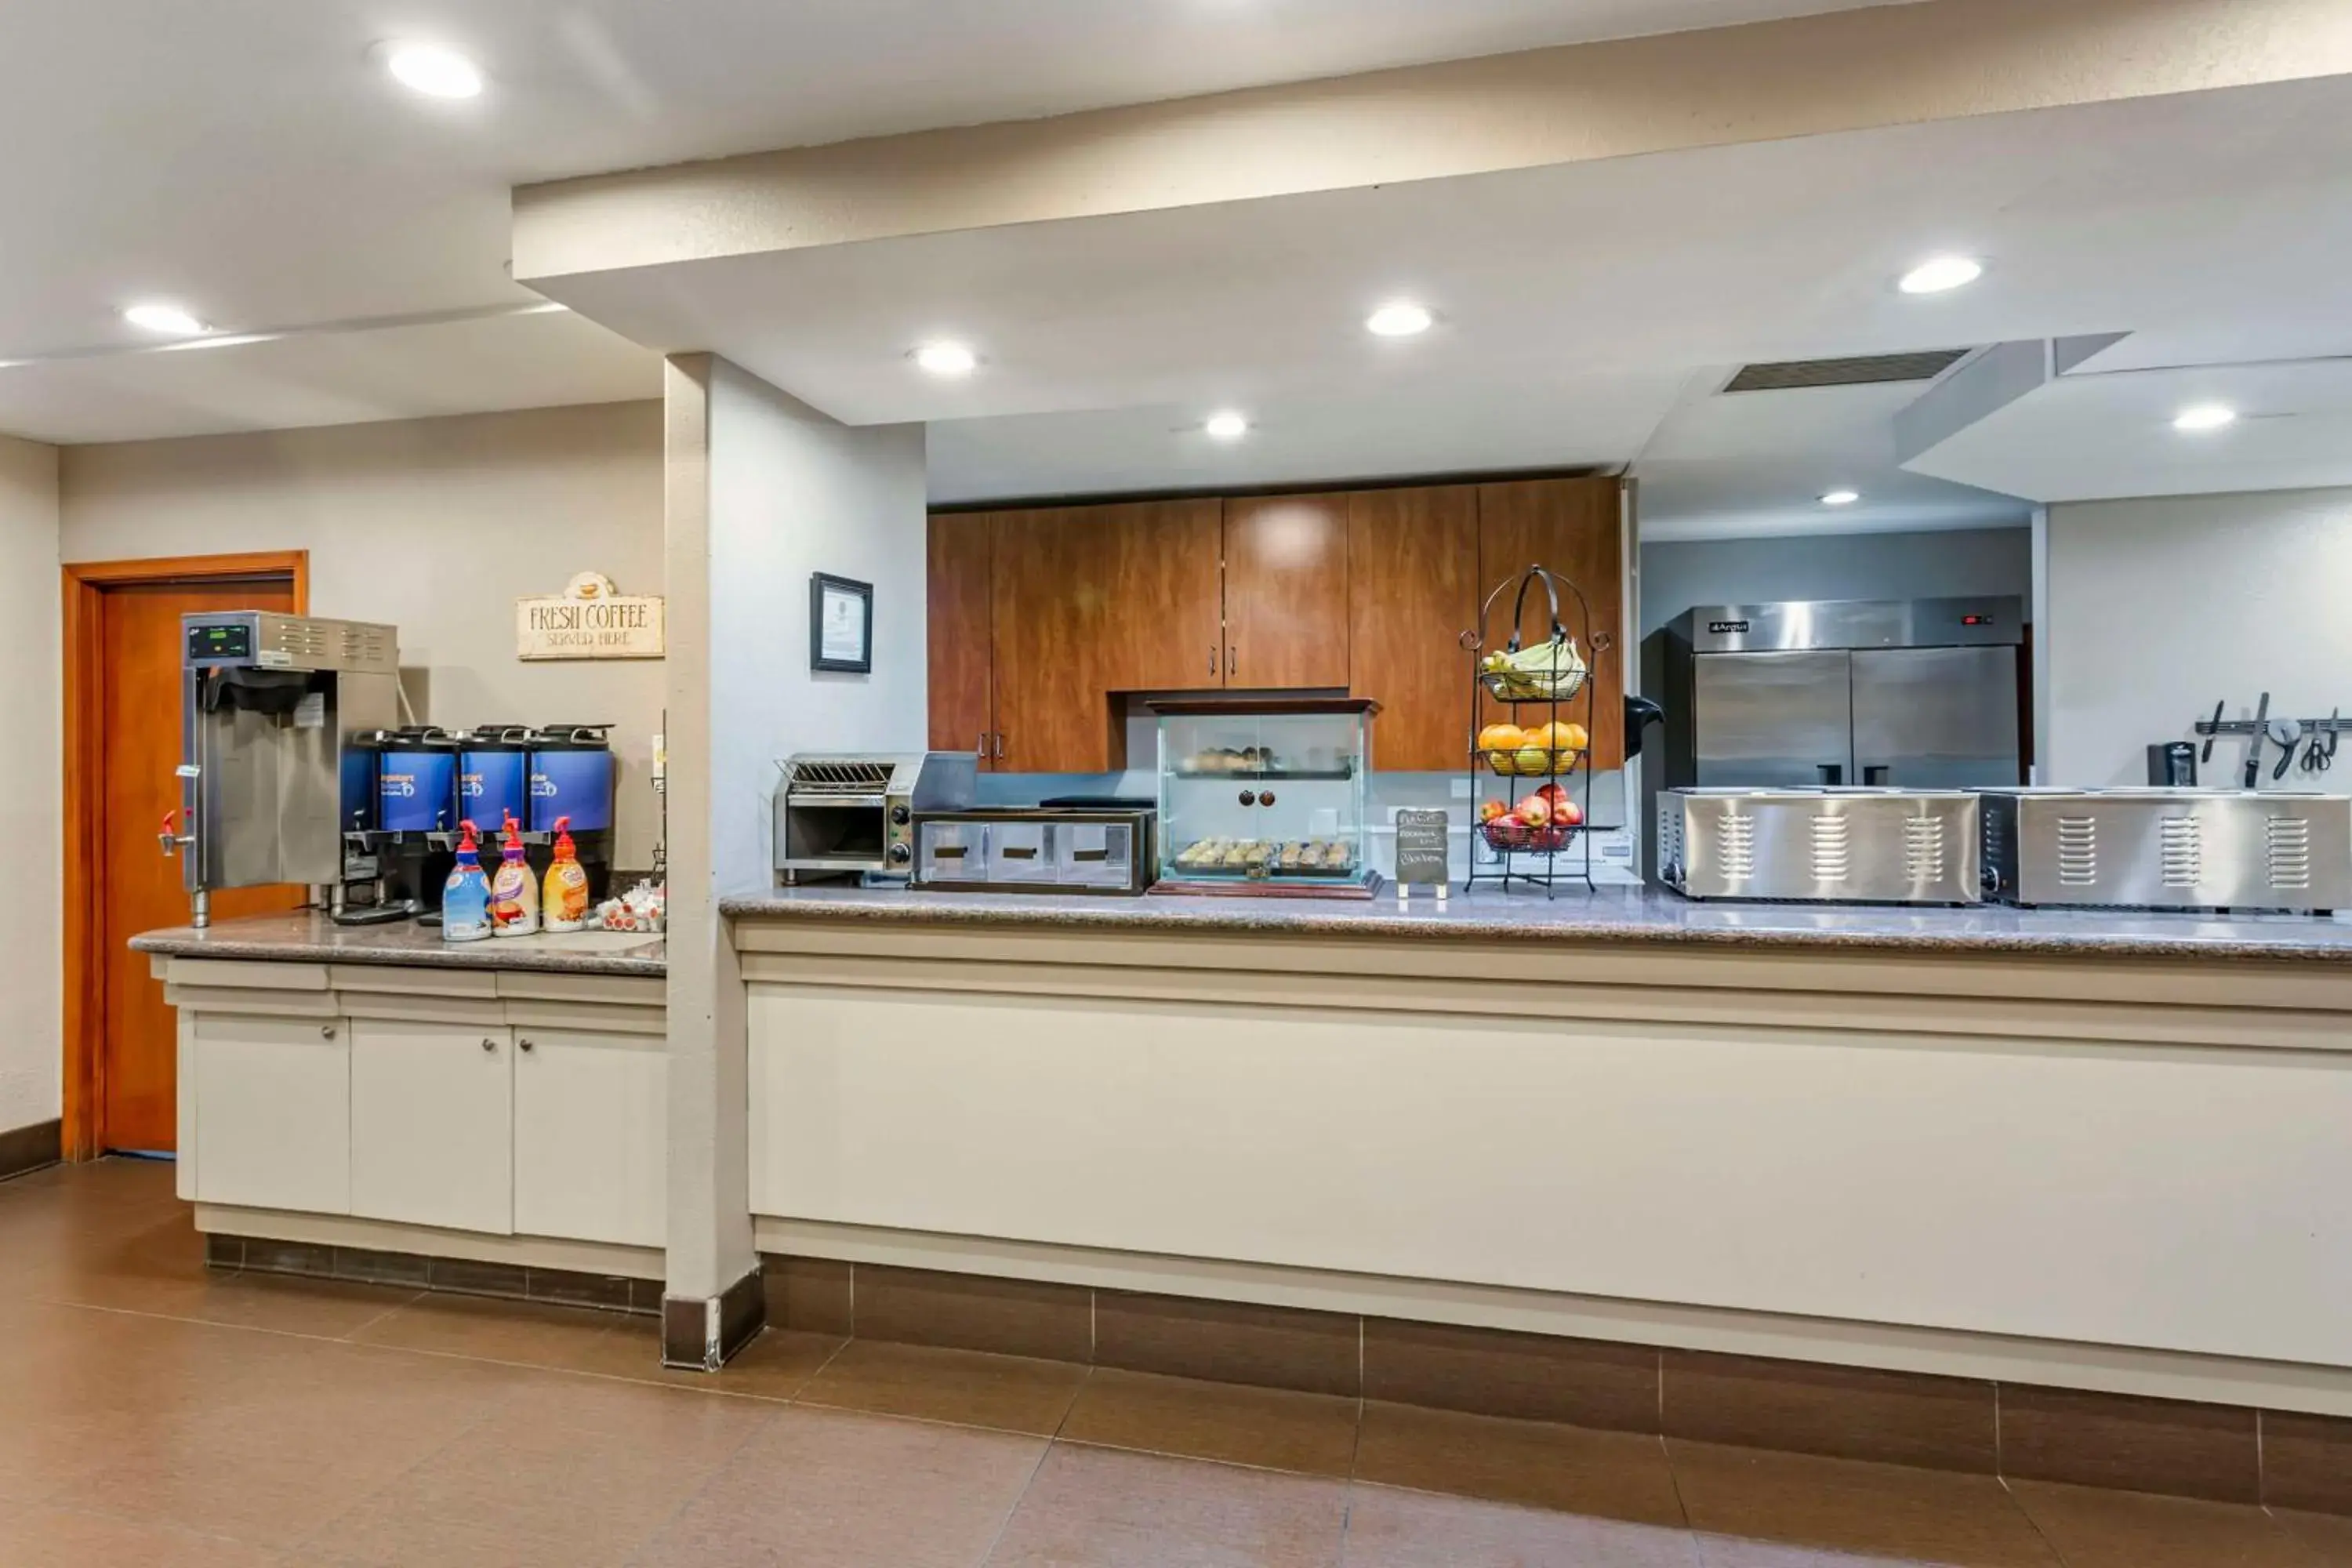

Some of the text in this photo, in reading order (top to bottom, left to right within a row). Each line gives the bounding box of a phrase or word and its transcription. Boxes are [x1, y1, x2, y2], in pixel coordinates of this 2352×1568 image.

[530, 604, 648, 630] FRESH COFFEE
[548, 631, 630, 647] SERVED HERE
